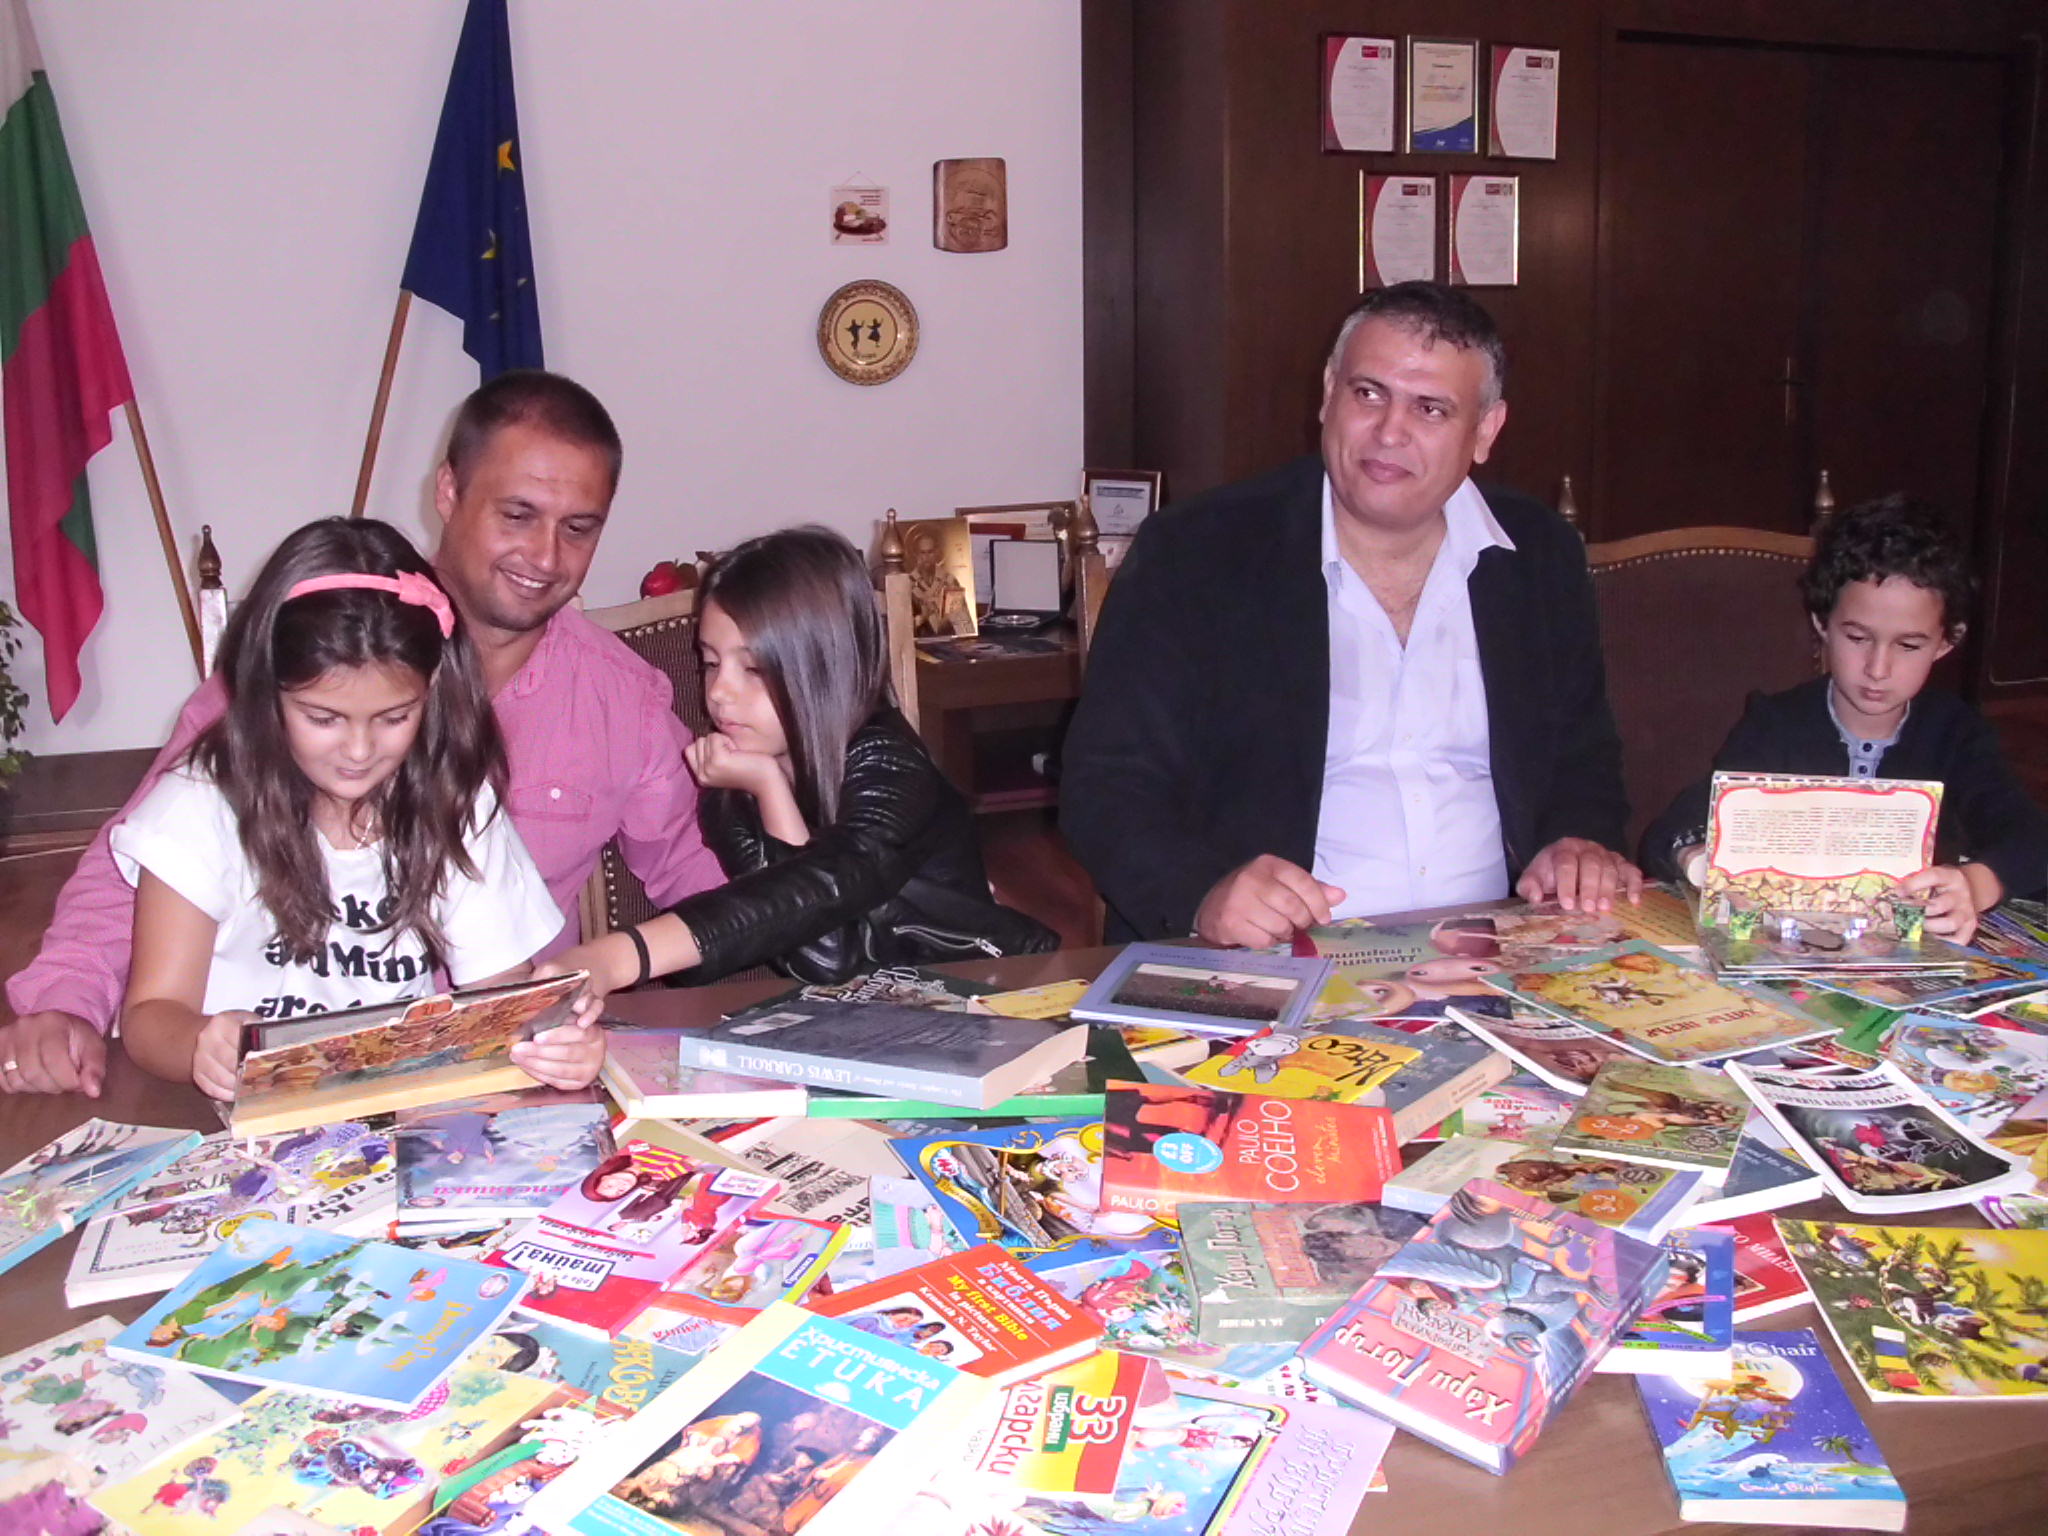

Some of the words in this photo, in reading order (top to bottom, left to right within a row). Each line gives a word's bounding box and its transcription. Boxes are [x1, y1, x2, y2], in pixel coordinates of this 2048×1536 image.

[737, 1055, 804, 1076] CARROLL
[807, 1066, 853, 1083] LEWIS
[1237, 1119, 1261, 1165] PAULO
[1259, 1101, 1300, 1192] COELHO
[1110, 1194, 1159, 1212] PAULO
[511, 1245, 606, 1274] тайна!
[919, 1286, 958, 1317] Kenneth
[966, 1324, 999, 1353] Taylor
[946, 1274, 970, 1292] My
[966, 1289, 998, 1315] first
[993, 1313, 1029, 1341] Bible
[948, 1291, 962, 1302] in
[957, 1300, 1000, 1333] pictures
[975, 1261, 1063, 1331] Библия
[1334, 1319, 1433, 1388] Потър
[1046, 1392, 1072, 1445] избрани
[1067, 1391, 1128, 1444] 33
[1428, 1368, 1513, 1426] Хари
